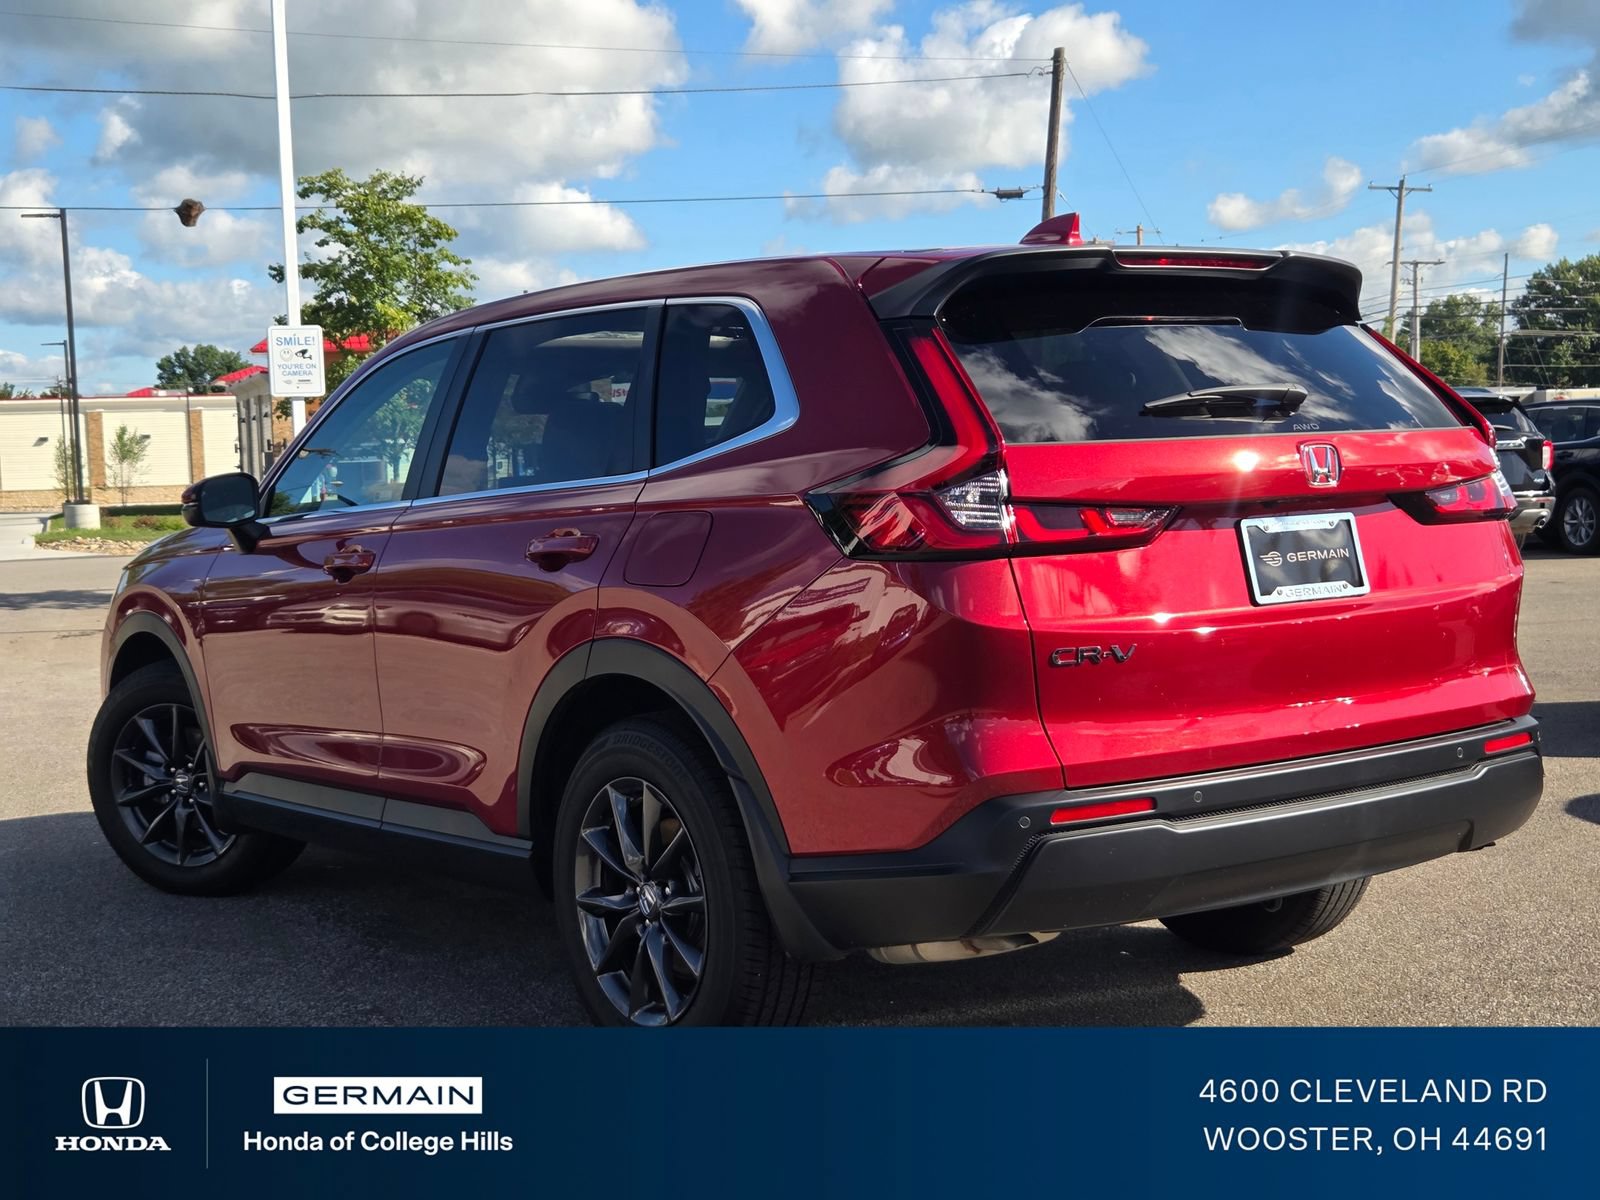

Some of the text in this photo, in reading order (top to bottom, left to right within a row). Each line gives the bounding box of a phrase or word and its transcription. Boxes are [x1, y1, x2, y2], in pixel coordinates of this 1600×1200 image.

[275, 336, 316, 346] SMILE!
[1293, 423, 1320, 431] AWD
[1286, 548, 1350, 562] GERMAIN
[1285, 585, 1343, 598] GERMAIN
[1051, 643, 1137, 665] CR-V
[613, 734, 690, 784] BRIDGESTONE
